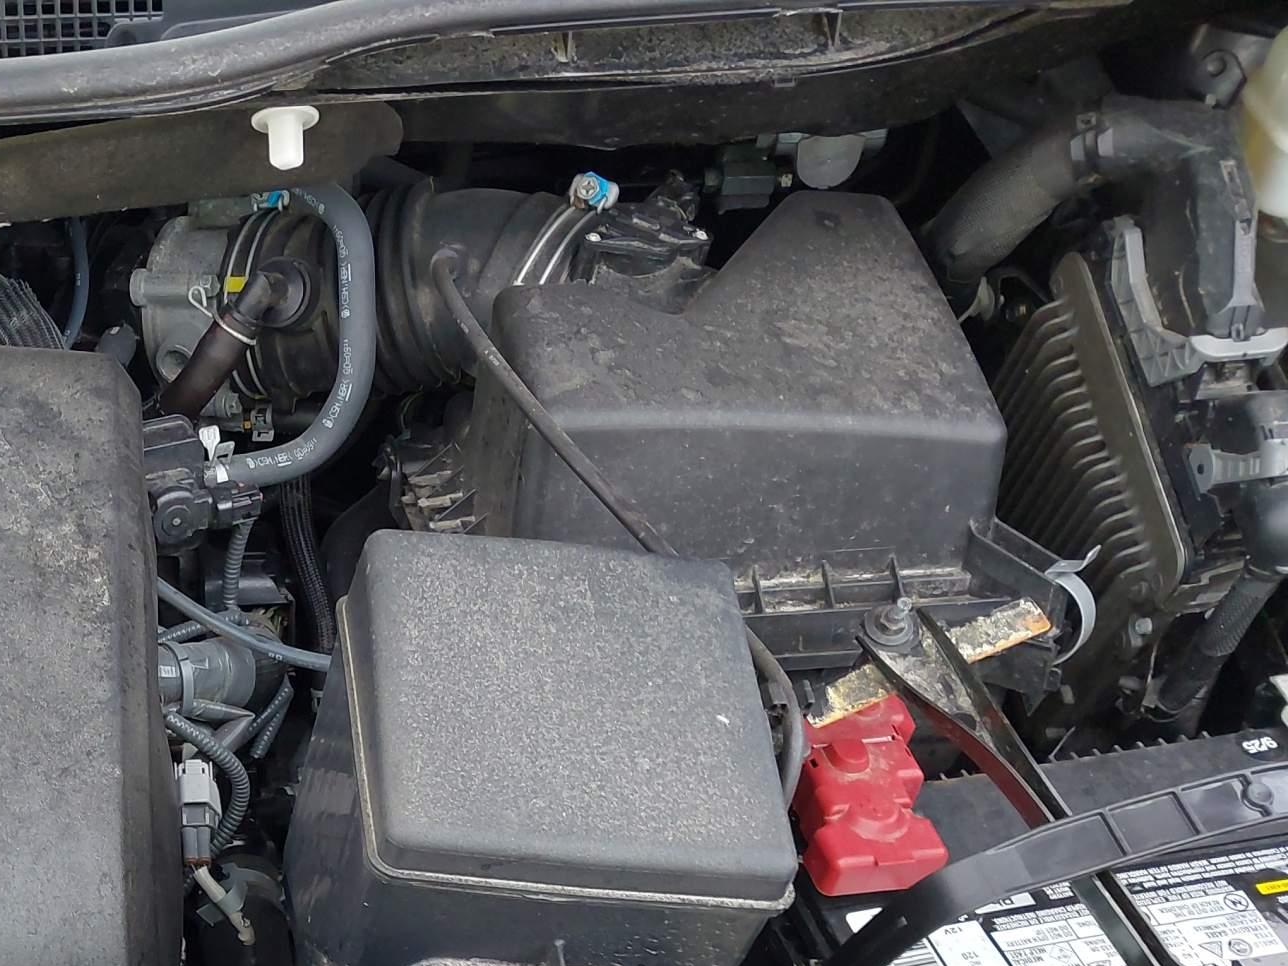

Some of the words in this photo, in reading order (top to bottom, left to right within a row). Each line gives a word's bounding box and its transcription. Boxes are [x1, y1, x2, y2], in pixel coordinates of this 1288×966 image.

[1242, 736, 1279, 754] 9/25
[944, 926, 963, 935] 12V
[960, 951, 980, 960] 120
